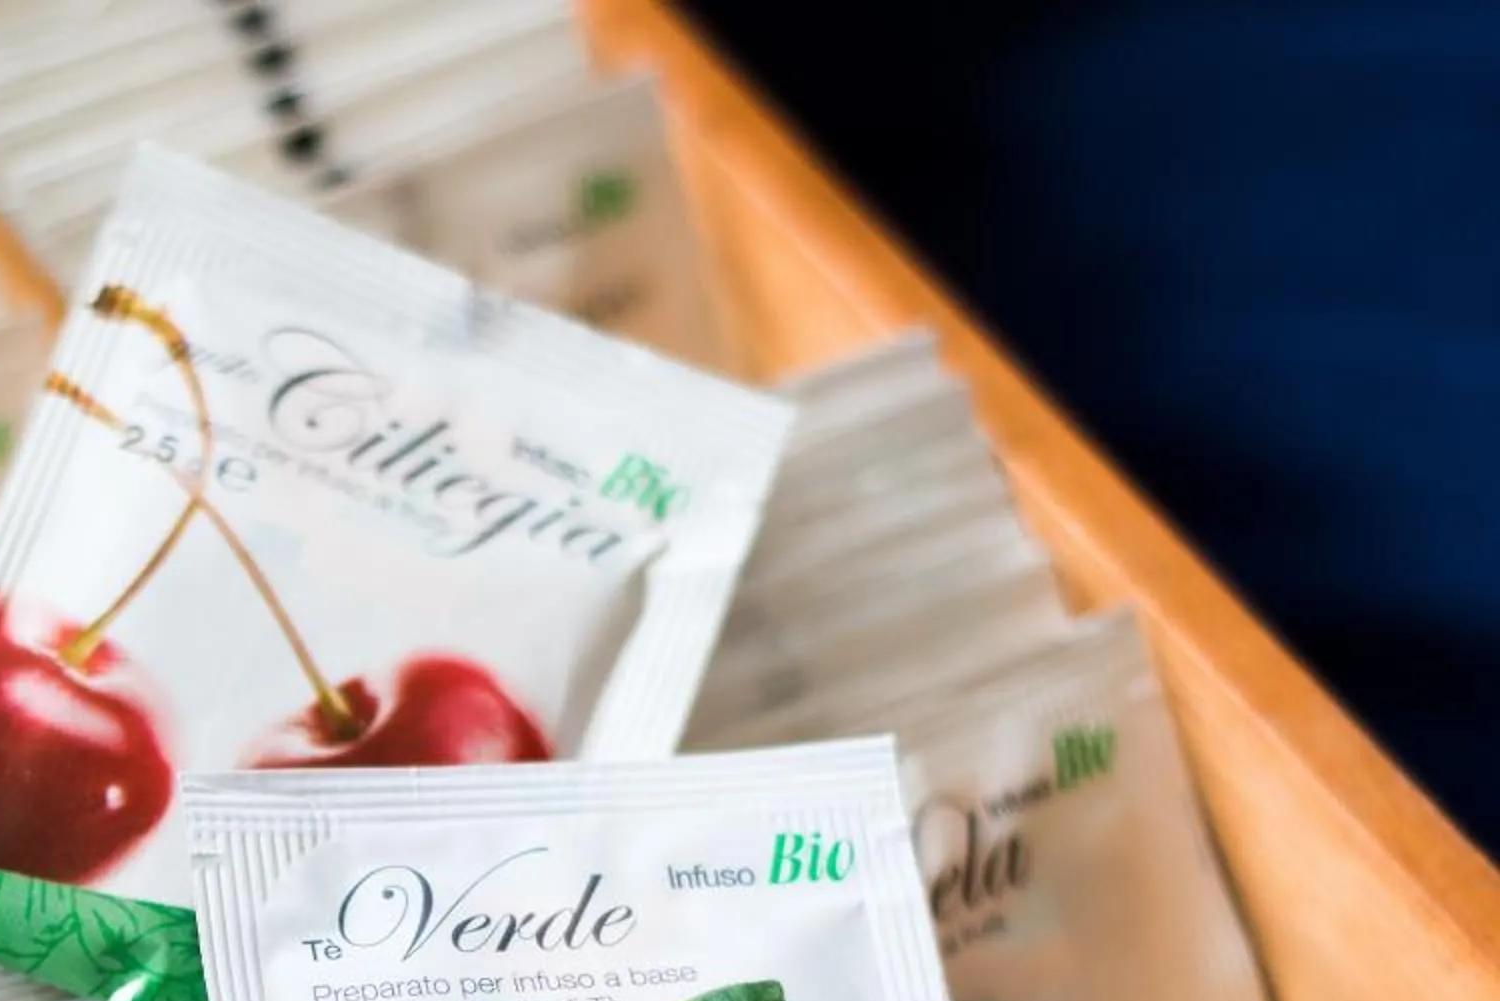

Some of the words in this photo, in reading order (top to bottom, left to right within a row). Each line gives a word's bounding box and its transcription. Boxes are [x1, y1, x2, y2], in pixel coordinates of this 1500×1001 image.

[262, 326, 624, 562] Ciliegia
[301, 938, 343, 962] Tè
[337, 847, 638, 962] Verde
[667, 864, 756, 891] Infuso
[768, 831, 855, 886] Bio
[459, 976, 504, 1000] per
[513, 969, 595, 993] infuso
[605, 971, 621, 988] a
[628, 965, 698, 987] base
